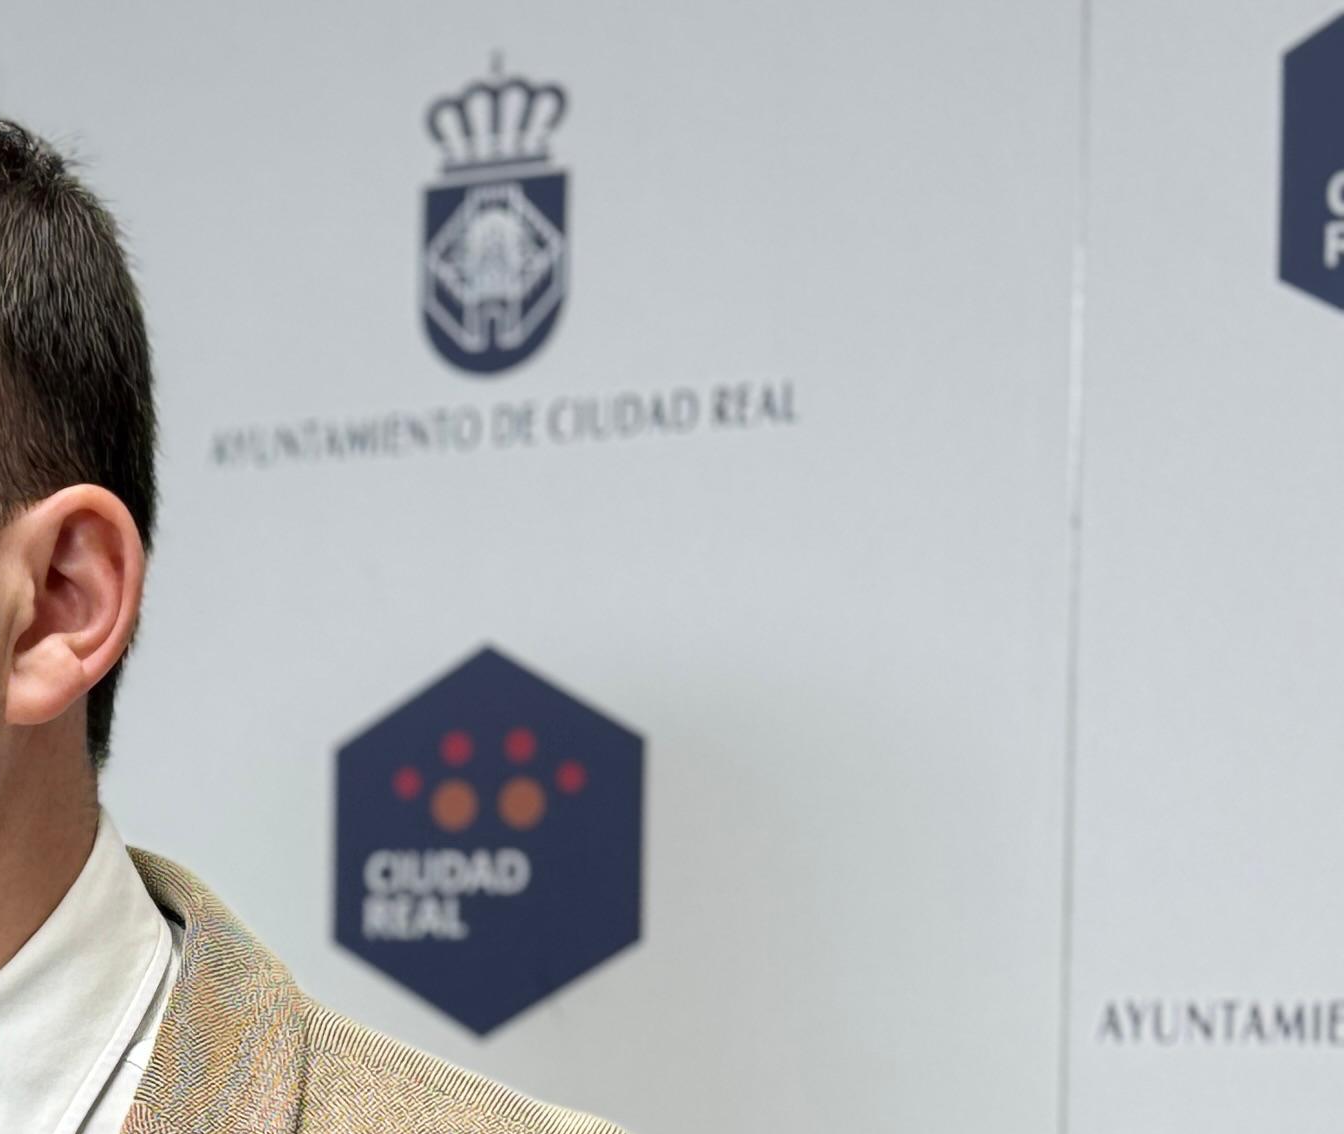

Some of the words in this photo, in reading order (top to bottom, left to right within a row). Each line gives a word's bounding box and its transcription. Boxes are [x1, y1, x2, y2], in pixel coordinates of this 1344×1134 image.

[209, 404, 484, 467] AYUNTAMIENTO
[490, 400, 537, 447] DE
[546, 387, 700, 443] CIUDAD
[710, 380, 798, 428] REAL
[364, 848, 531, 895] CIUDAD
[362, 894, 468, 939] REAL
